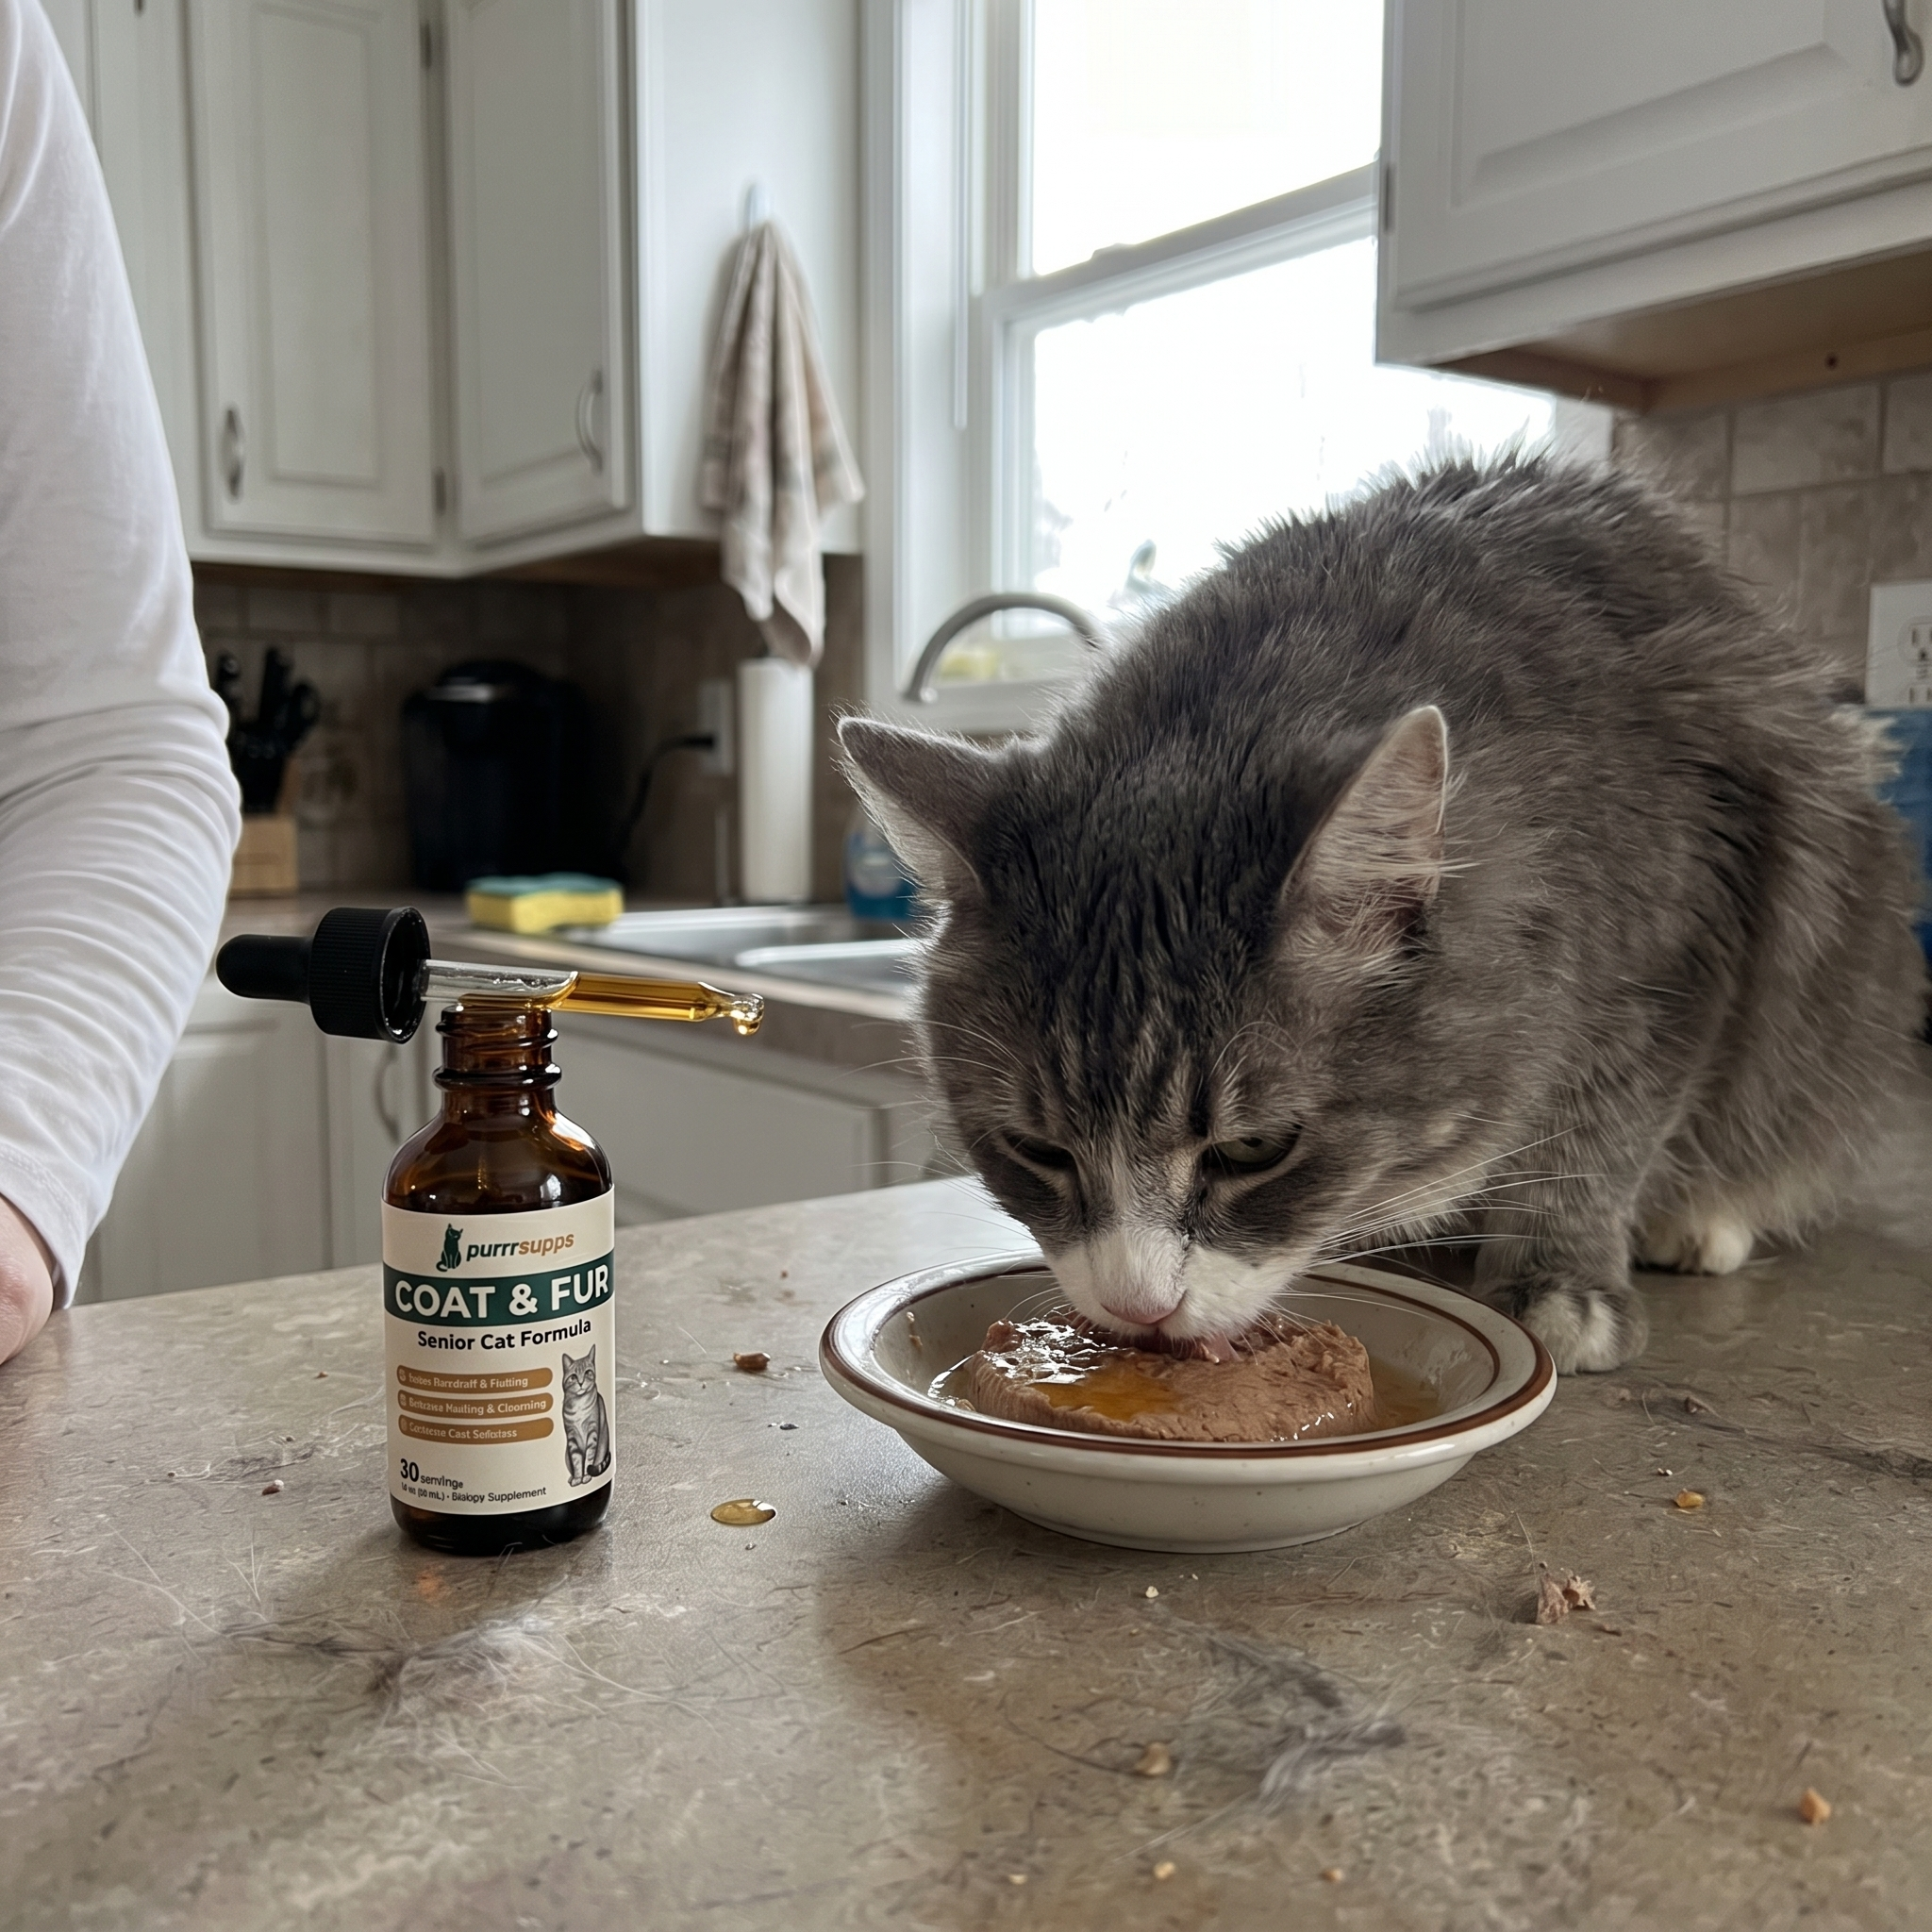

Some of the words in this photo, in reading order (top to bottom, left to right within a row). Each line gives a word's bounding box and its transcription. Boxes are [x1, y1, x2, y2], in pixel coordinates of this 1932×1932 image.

[466, 1234, 575, 1261] purrrsupps
[395, 1280, 495, 1318] COAT
[508, 1284, 538, 1316] &
[551, 1264, 609, 1310] FUR
[418, 1331, 475, 1350] Senior
[481, 1334, 515, 1349] Cat
[521, 1319, 591, 1346] Formula
[479, 1379, 487, 1389] &
[486, 1404, 495, 1413] &
[448, 1428, 471, 1439] Cast
[400, 1458, 419, 1482] 30
[488, 1487, 546, 1503] Supplement
